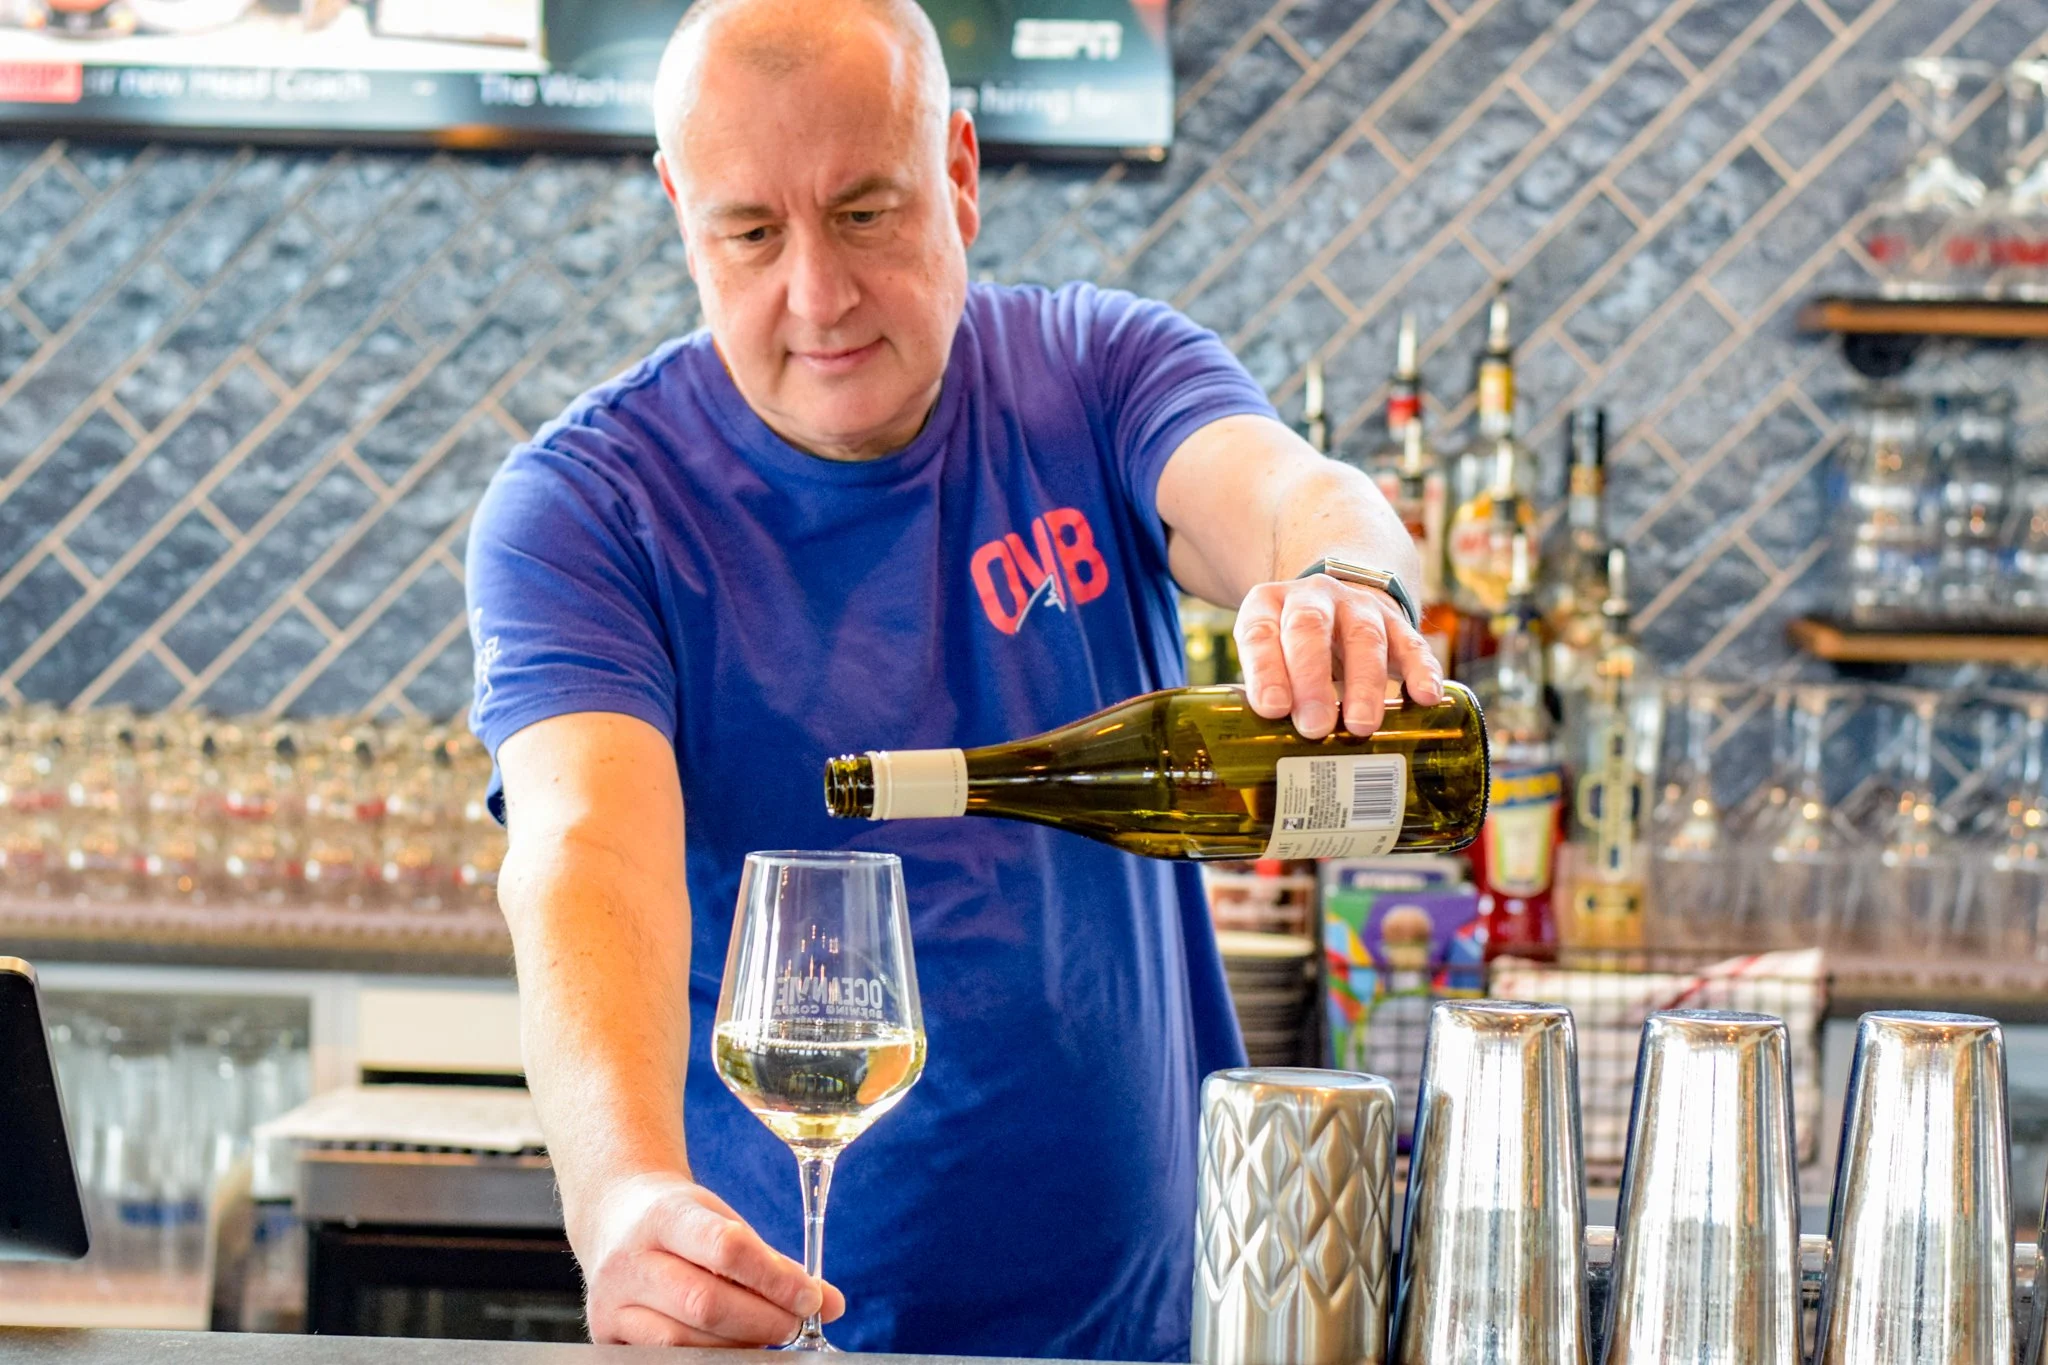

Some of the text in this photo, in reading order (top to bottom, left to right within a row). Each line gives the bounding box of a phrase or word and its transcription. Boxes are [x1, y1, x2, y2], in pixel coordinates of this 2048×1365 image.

[1012, 18, 1123, 61] ESPN
[274, 70, 372, 102] Coach
[481, 73, 536, 106] The
[981, 80, 1071, 125] hiring
[970, 507, 1109, 635] OVB
